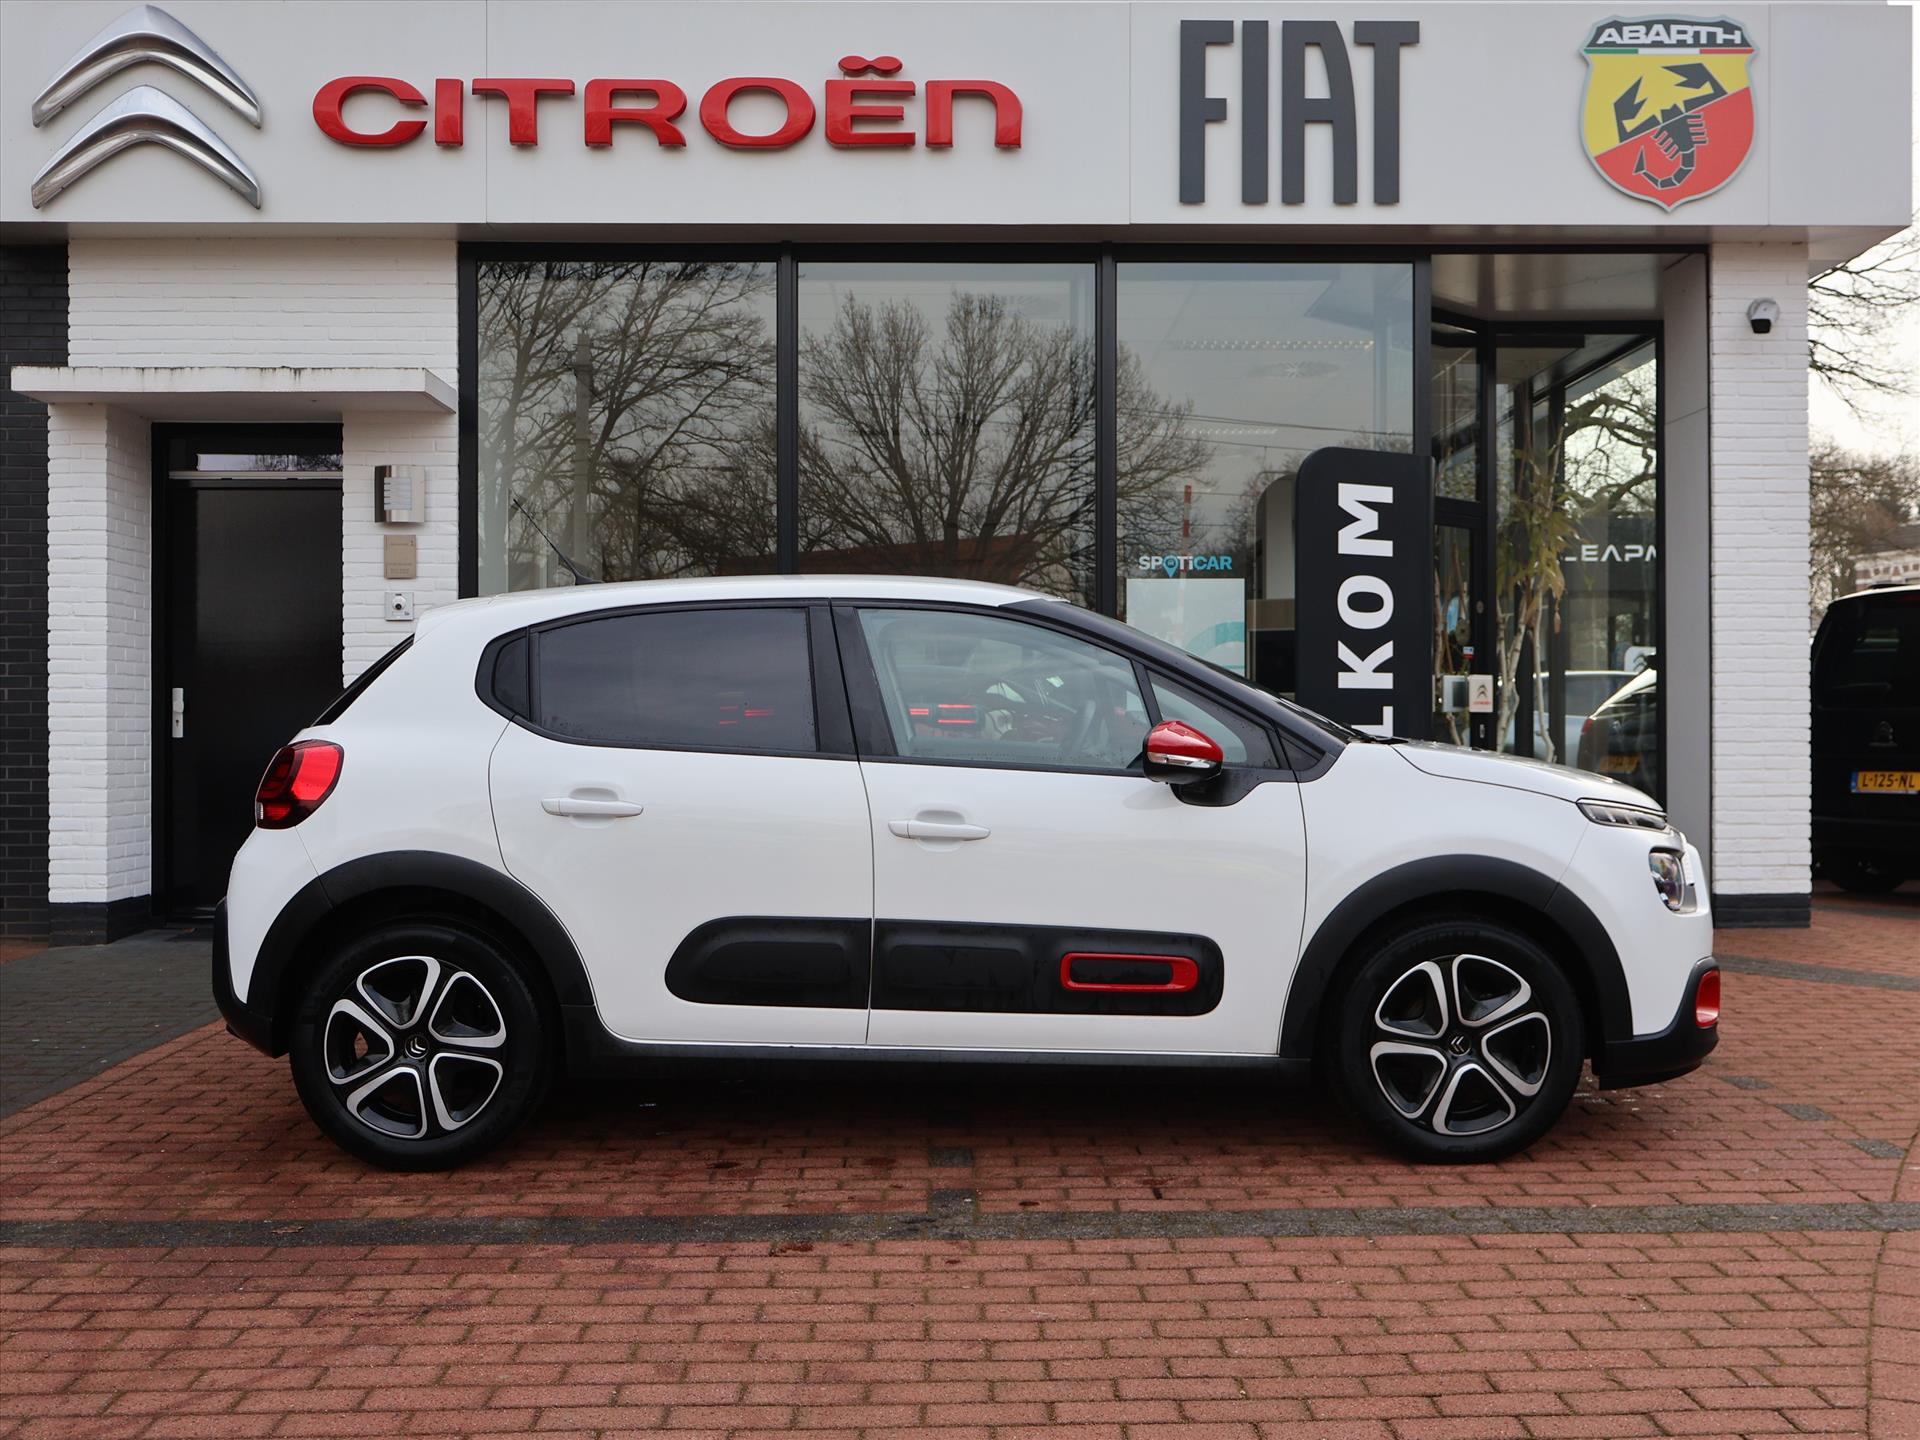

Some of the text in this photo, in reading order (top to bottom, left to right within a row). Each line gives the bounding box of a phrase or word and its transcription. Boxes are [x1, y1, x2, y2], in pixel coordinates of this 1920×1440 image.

[1597, 23, 1741, 45] ABARTH
[1180, 19, 1419, 206] FIAT
[1862, 773, 1915, 788] L-125-NL
